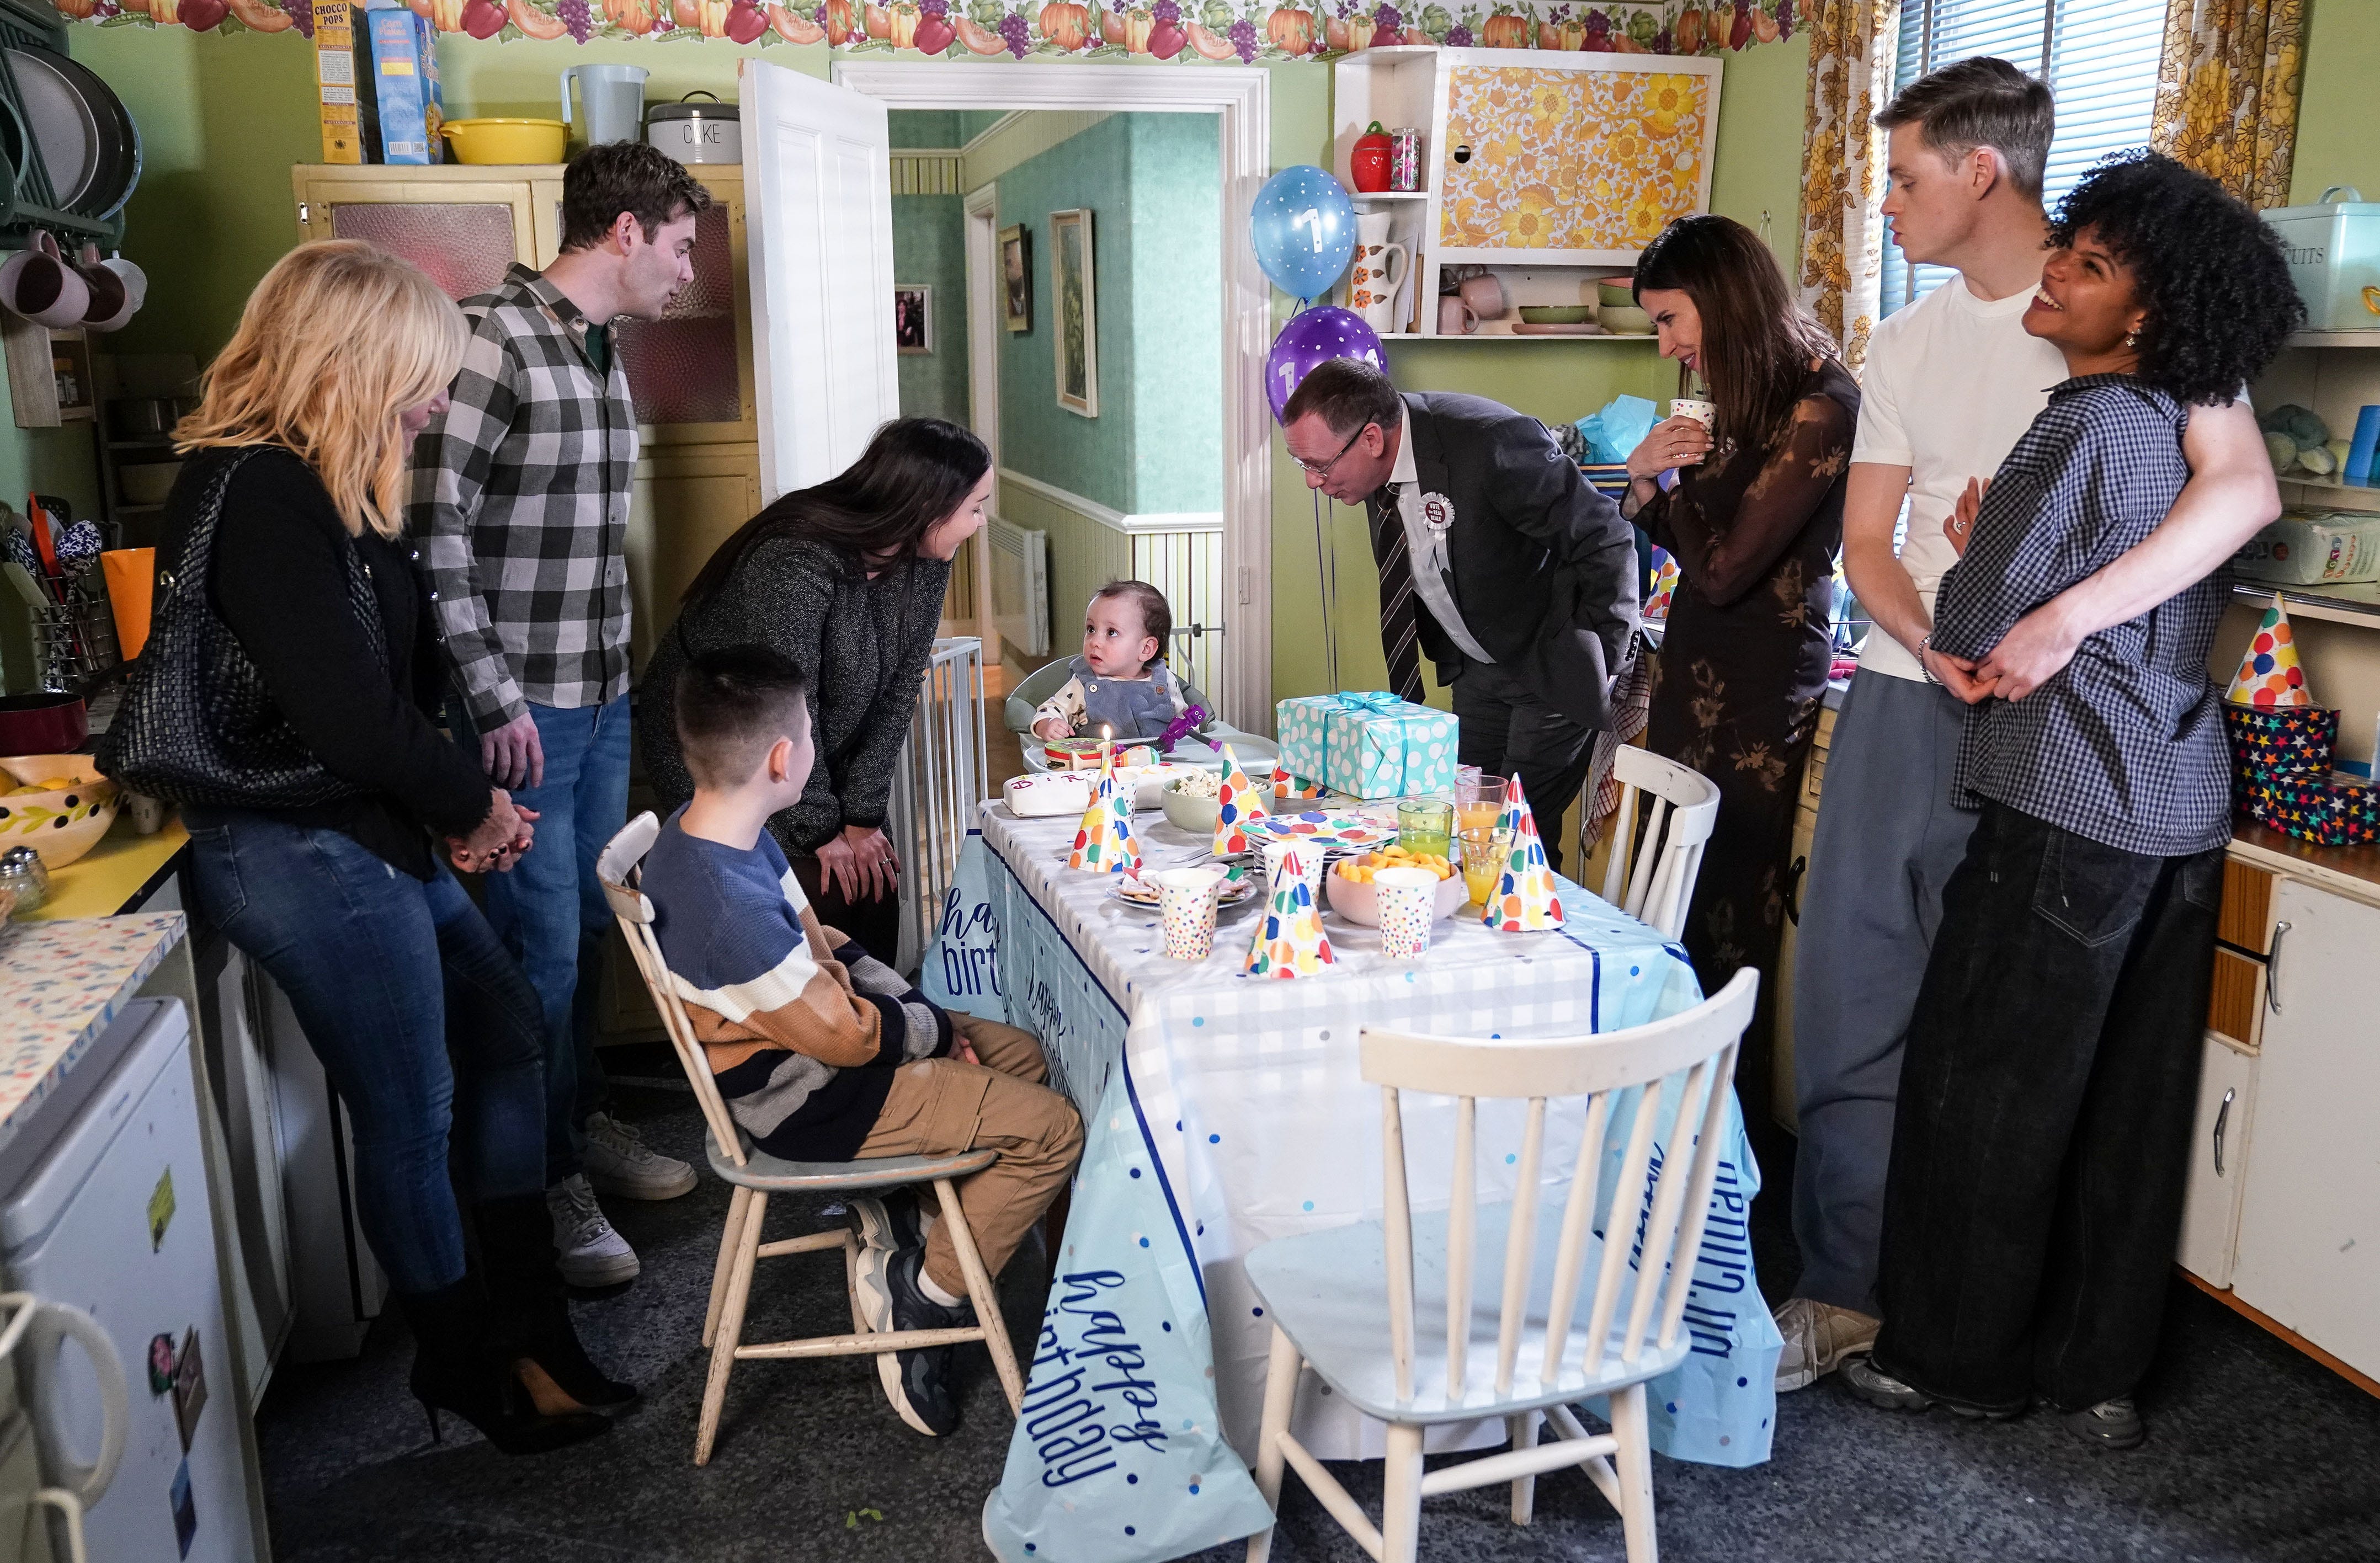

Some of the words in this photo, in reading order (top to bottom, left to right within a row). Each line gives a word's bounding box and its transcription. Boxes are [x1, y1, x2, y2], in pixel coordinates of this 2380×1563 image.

[315, 3, 348, 15] CHOCCO
[323, 14, 344, 25] POPS
[683, 124, 721, 144] CAKE
[1300, 208, 1323, 254] 1
[1060, 1270, 1168, 1454] happy
